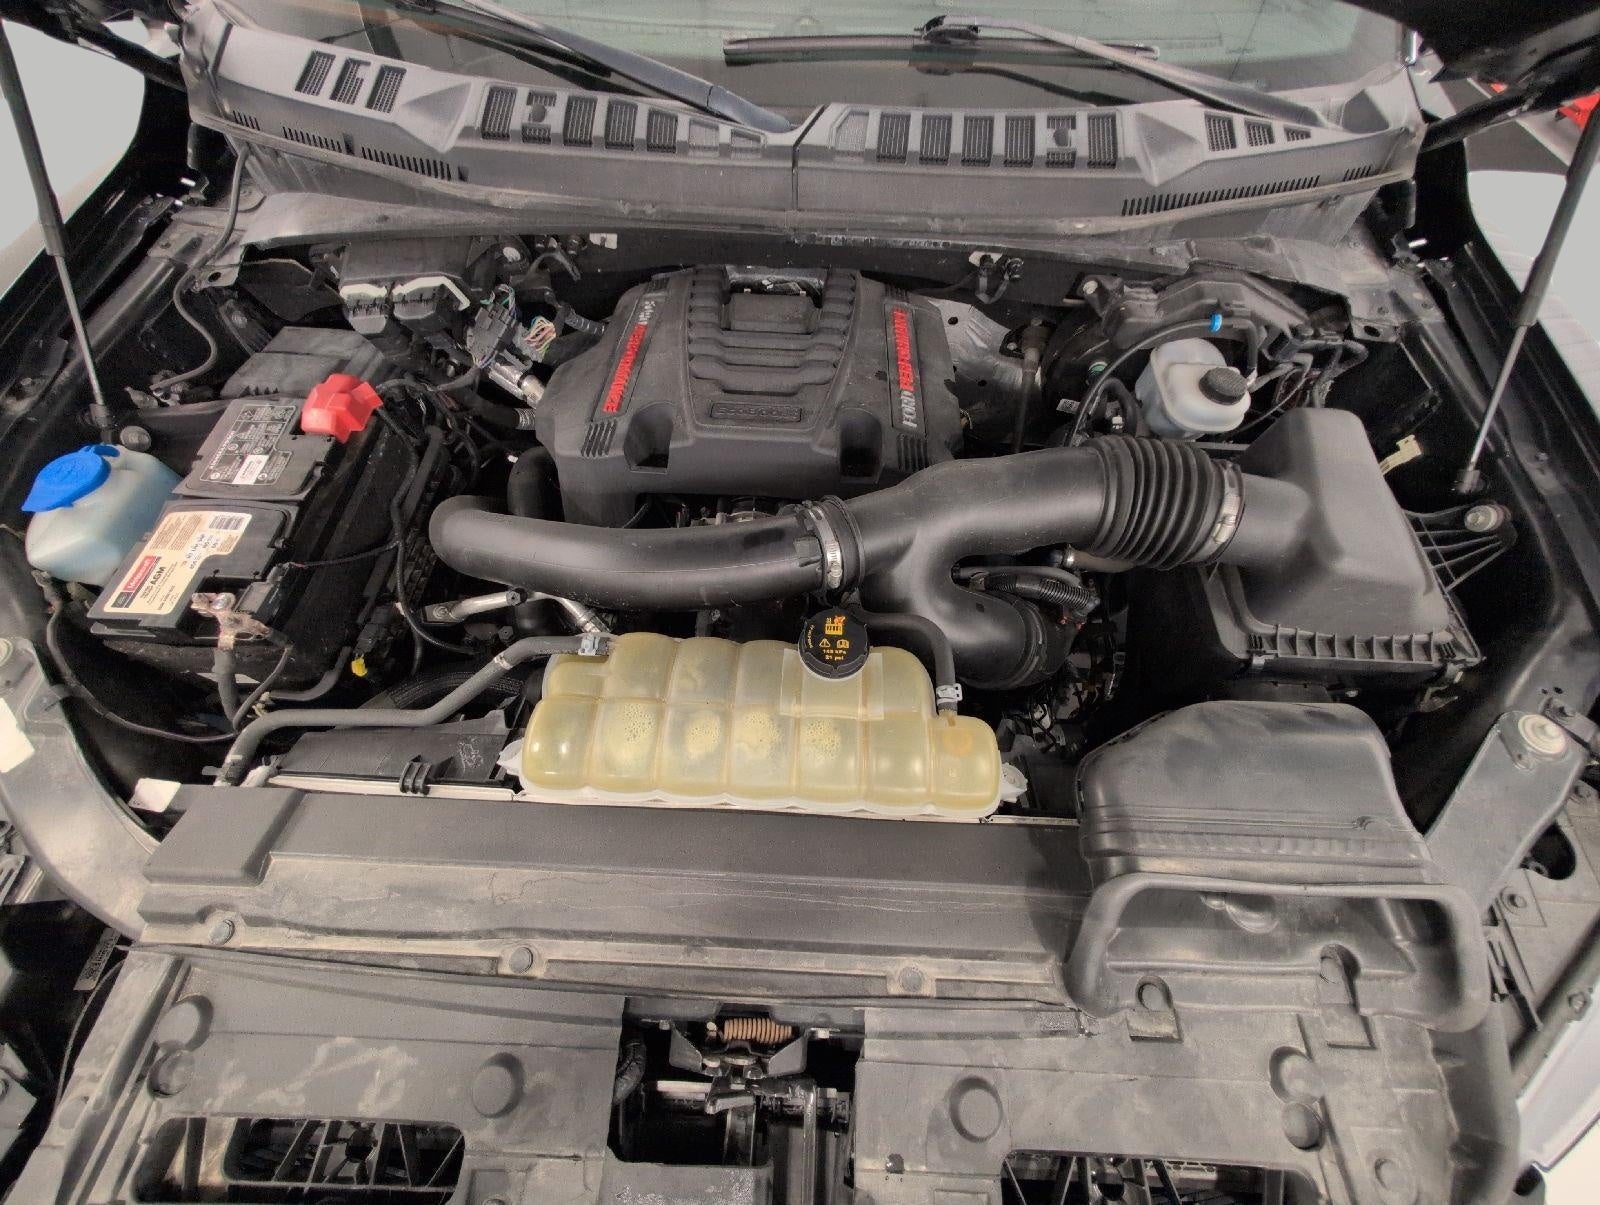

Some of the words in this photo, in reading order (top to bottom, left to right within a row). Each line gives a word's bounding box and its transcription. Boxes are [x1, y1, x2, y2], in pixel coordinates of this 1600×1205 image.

[892, 308, 914, 392] PERFORMANCE
[900, 390, 918, 428] FORD
[150, 566, 166, 584] AGM
